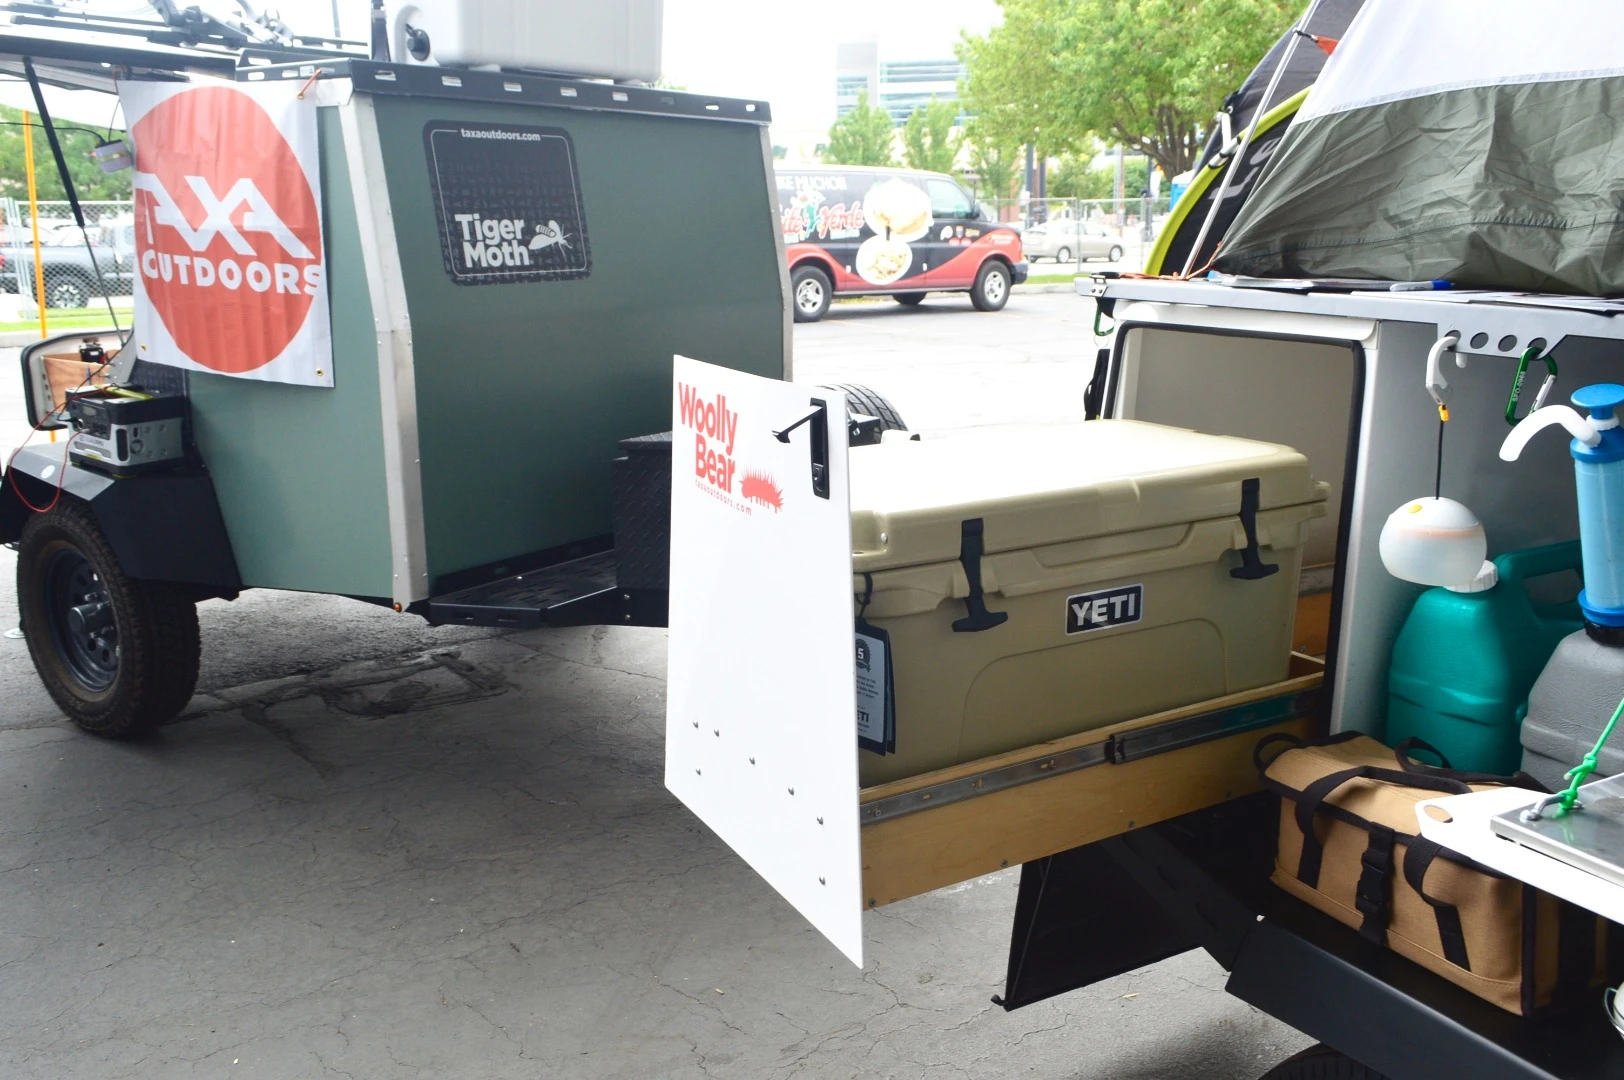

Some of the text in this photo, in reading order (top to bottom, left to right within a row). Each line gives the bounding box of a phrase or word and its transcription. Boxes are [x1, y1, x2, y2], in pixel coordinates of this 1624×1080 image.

[460, 128, 541, 141] taxaoutdoors.com
[454, 213, 525, 246] Tiger
[462, 240, 530, 268] Moth
[142, 249, 321, 296] OUTDOORS
[678, 381, 738, 456] Woolly
[695, 433, 736, 493] Bear
[1071, 593, 1136, 627] YETI
[857, 648, 864, 660] 5
[857, 709, 870, 723] ETI
